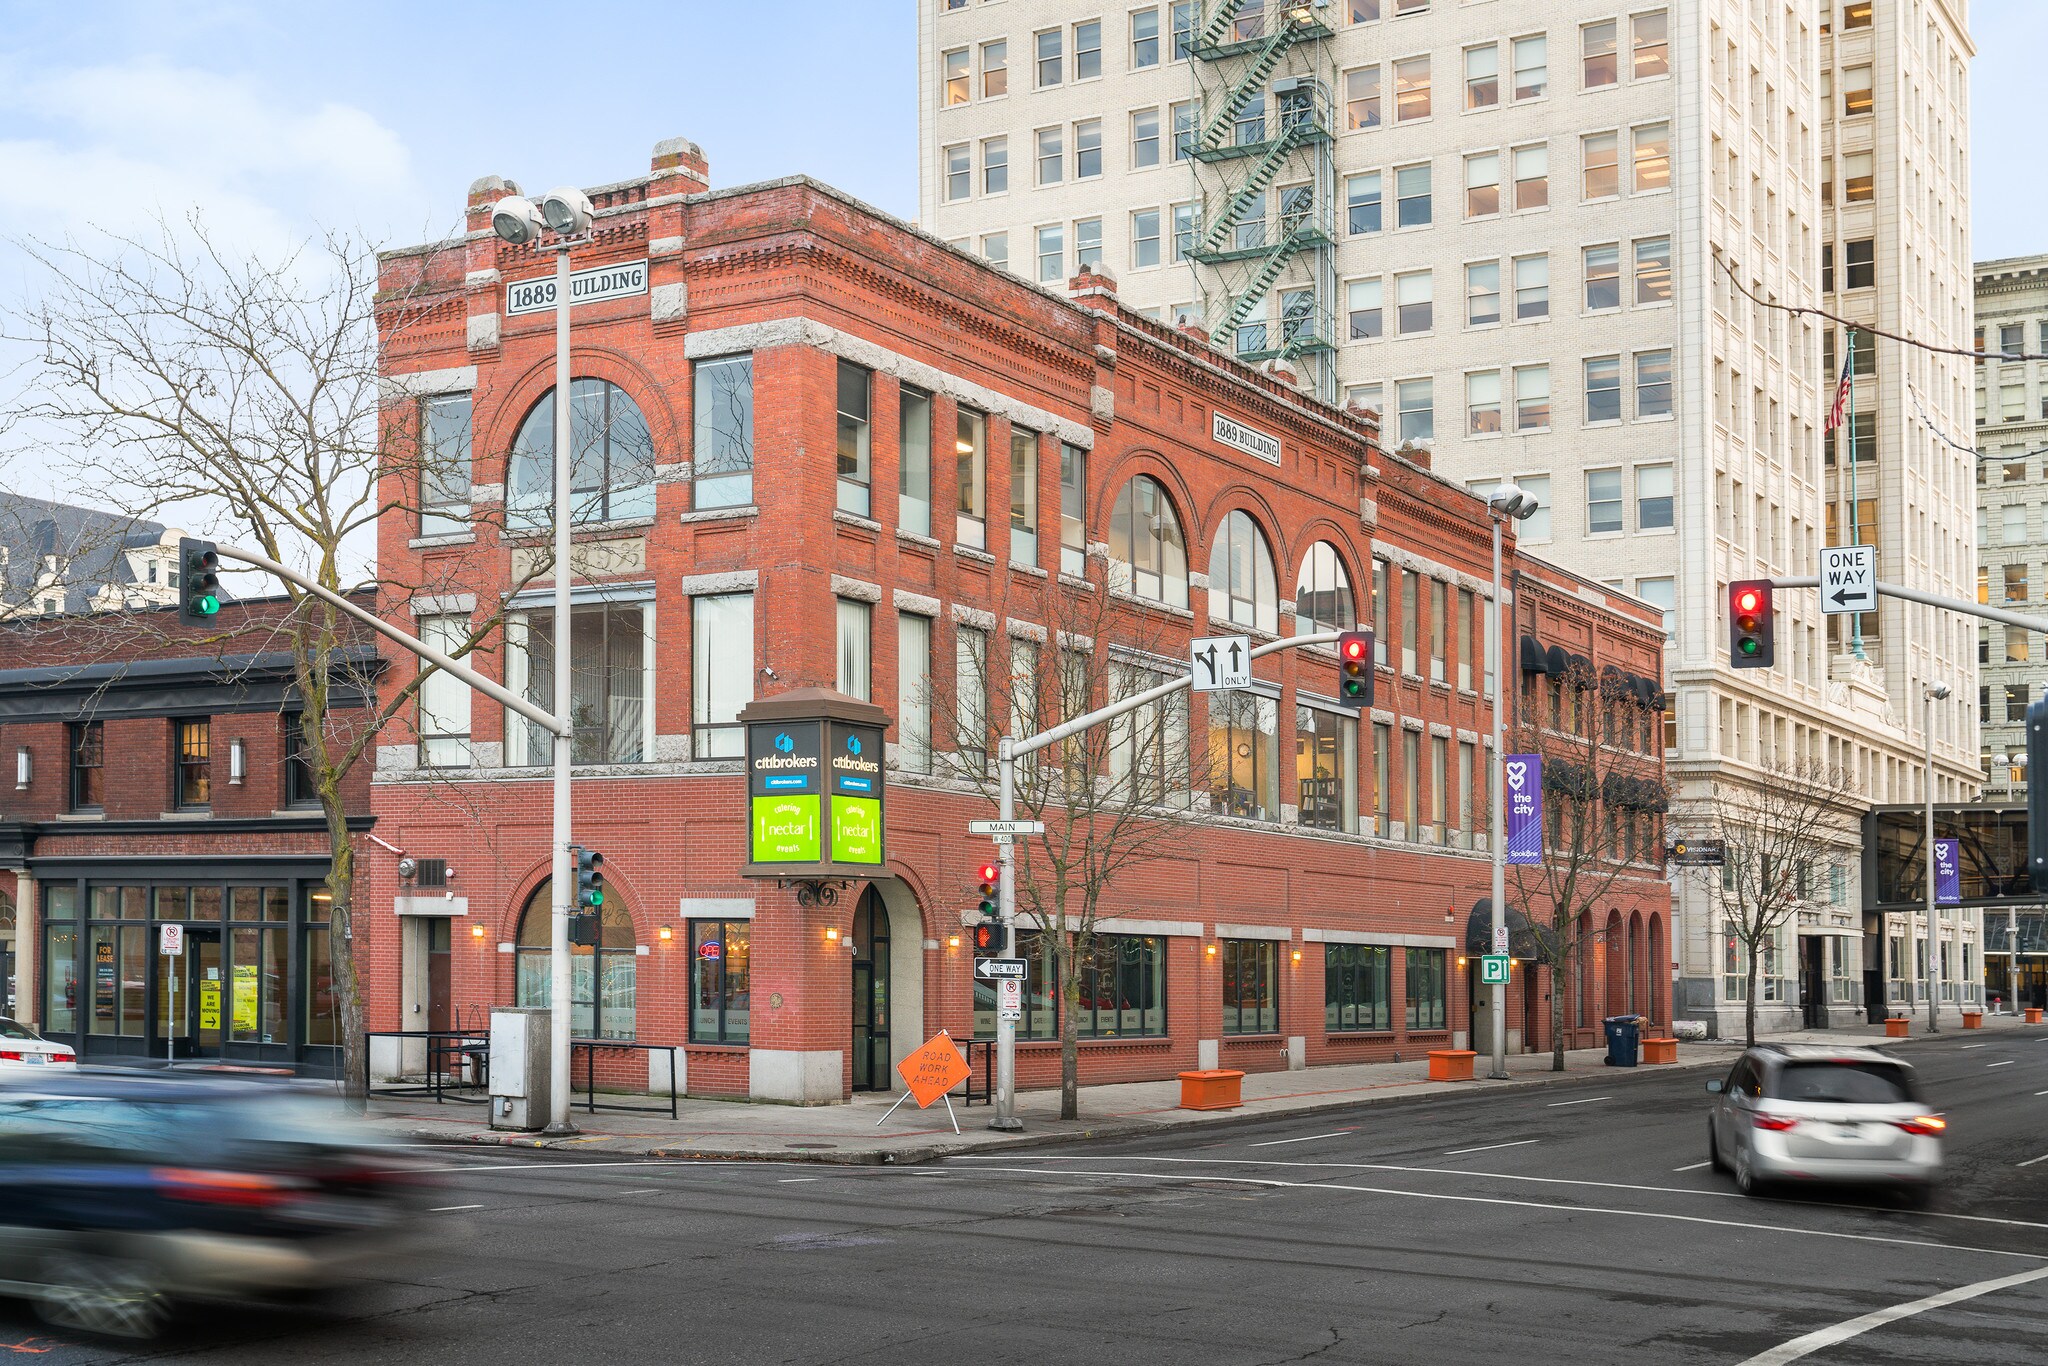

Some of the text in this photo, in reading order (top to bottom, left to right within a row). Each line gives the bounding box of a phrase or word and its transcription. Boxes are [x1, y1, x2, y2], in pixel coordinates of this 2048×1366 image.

[513, 269, 643, 308] 1889 UILDING
[1216, 419, 1277, 458] 1889 BUILDING
[1830, 552, 1865, 568] ONE
[1828, 570, 1866, 586] WAY
[1224, 676, 1248, 686] ONLY
[754, 752, 818, 770] citibrokers
[832, 754, 879, 773] citibrokers
[1514, 792, 1532, 802] the
[774, 803, 801, 816] catering
[845, 805, 866, 818] catering
[1514, 804, 1534, 816] city
[769, 822, 806, 836] nectar
[842, 824, 869, 838] nectar
[989, 823, 1016, 832] MAIN
[776, 844, 800, 853] events
[848, 846, 866, 854] events
[700, 945, 719, 956] OPE
[990, 964, 1003, 972] ONE
[922, 1052, 952, 1062] ROAD
[920, 1063, 948, 1074] WORK
[912, 1075, 948, 1086] AHEAD
